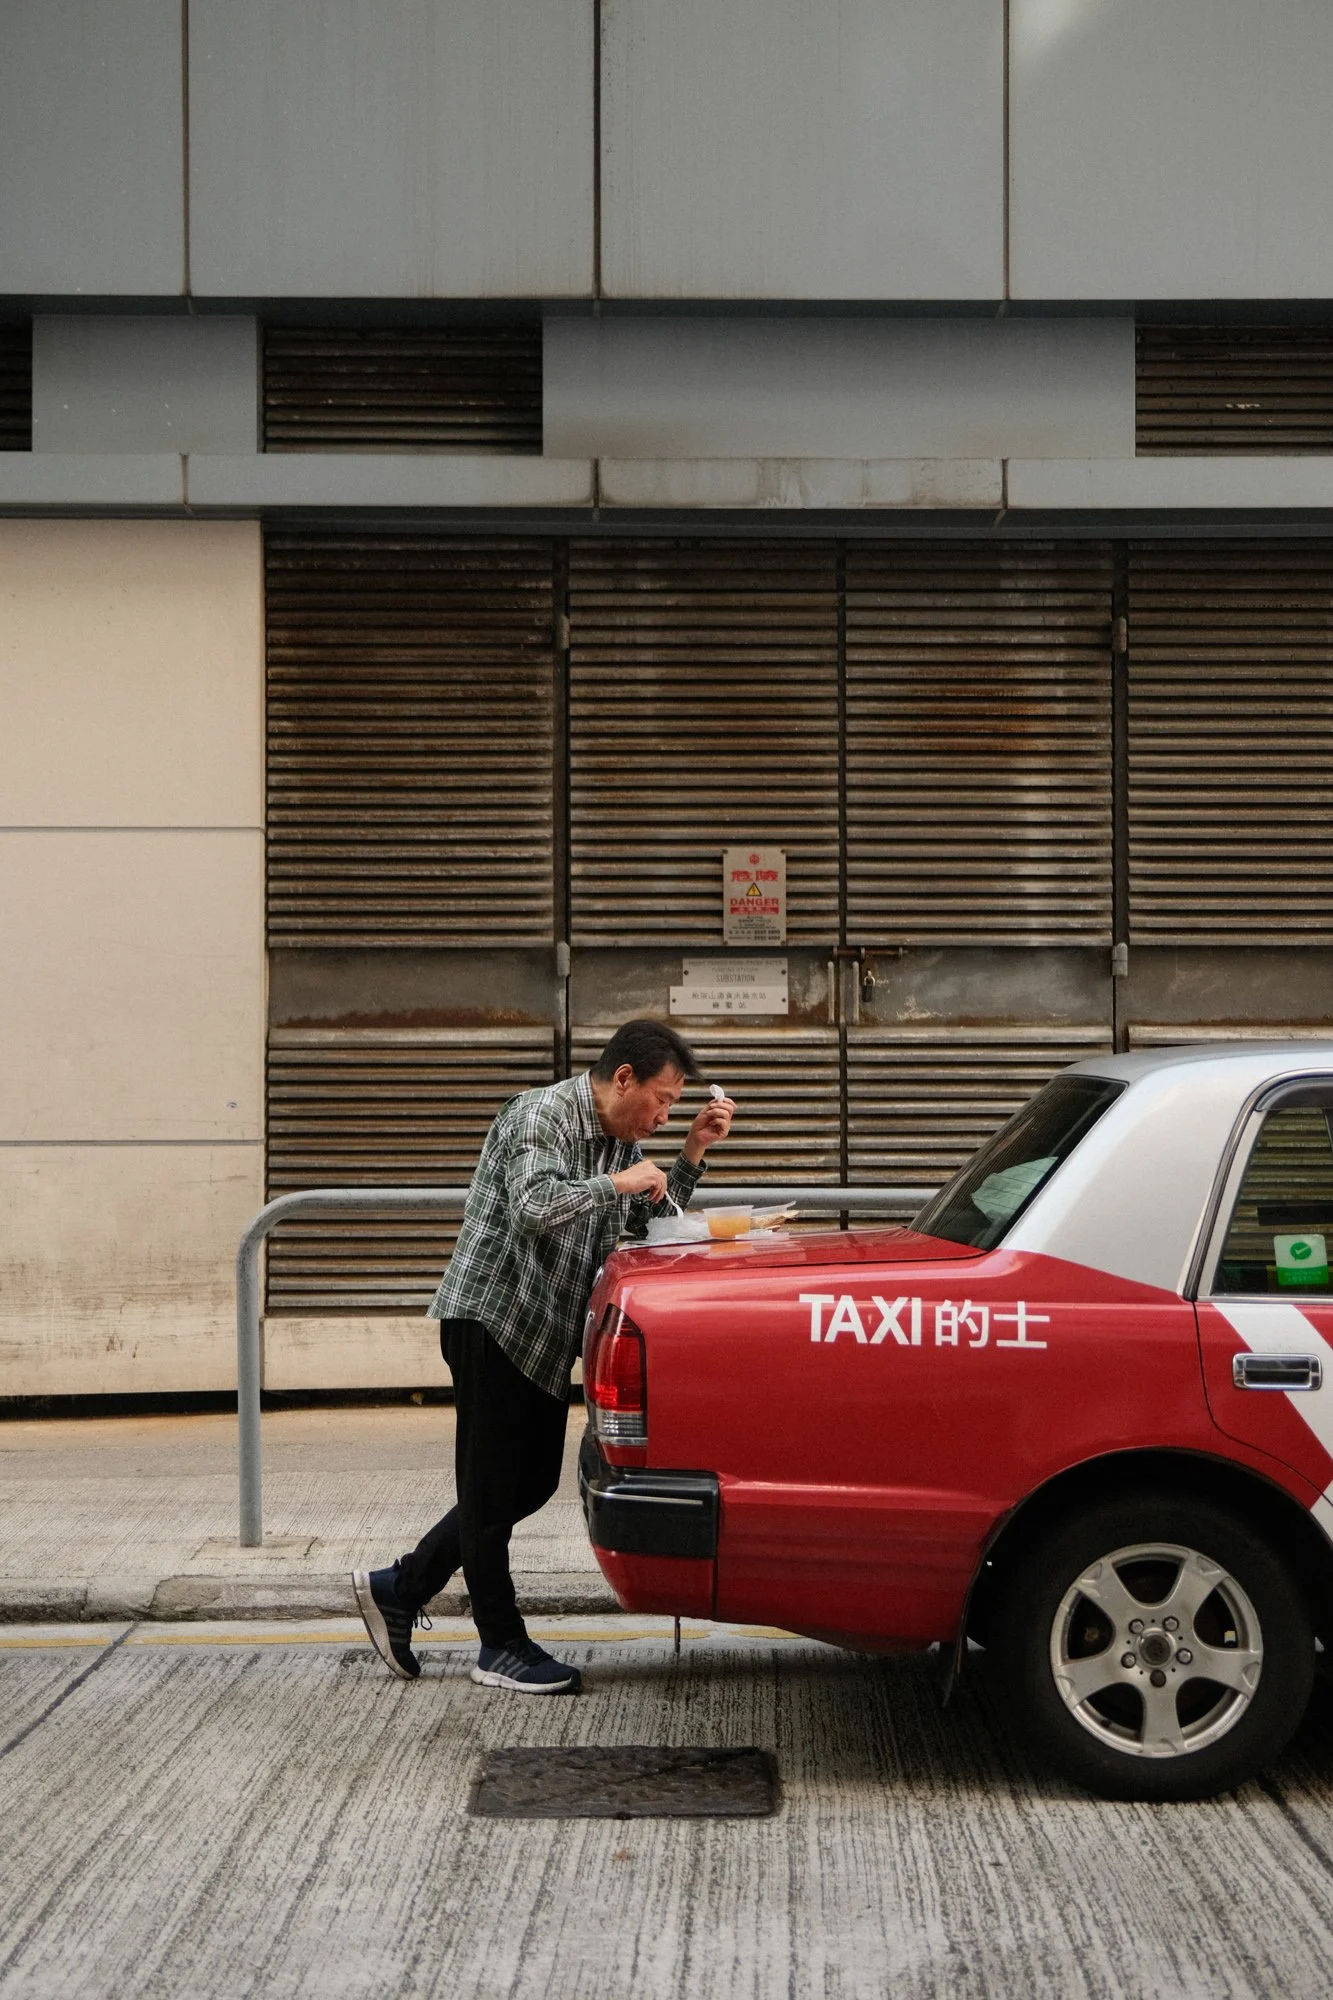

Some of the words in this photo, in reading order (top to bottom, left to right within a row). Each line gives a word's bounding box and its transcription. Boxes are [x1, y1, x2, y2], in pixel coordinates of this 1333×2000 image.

[731, 870, 778, 881] 危險
[715, 974, 756, 983] SUBSTATION
[799, 1293, 922, 1346] TAXI
[935, 1299, 1050, 1349] 的士
